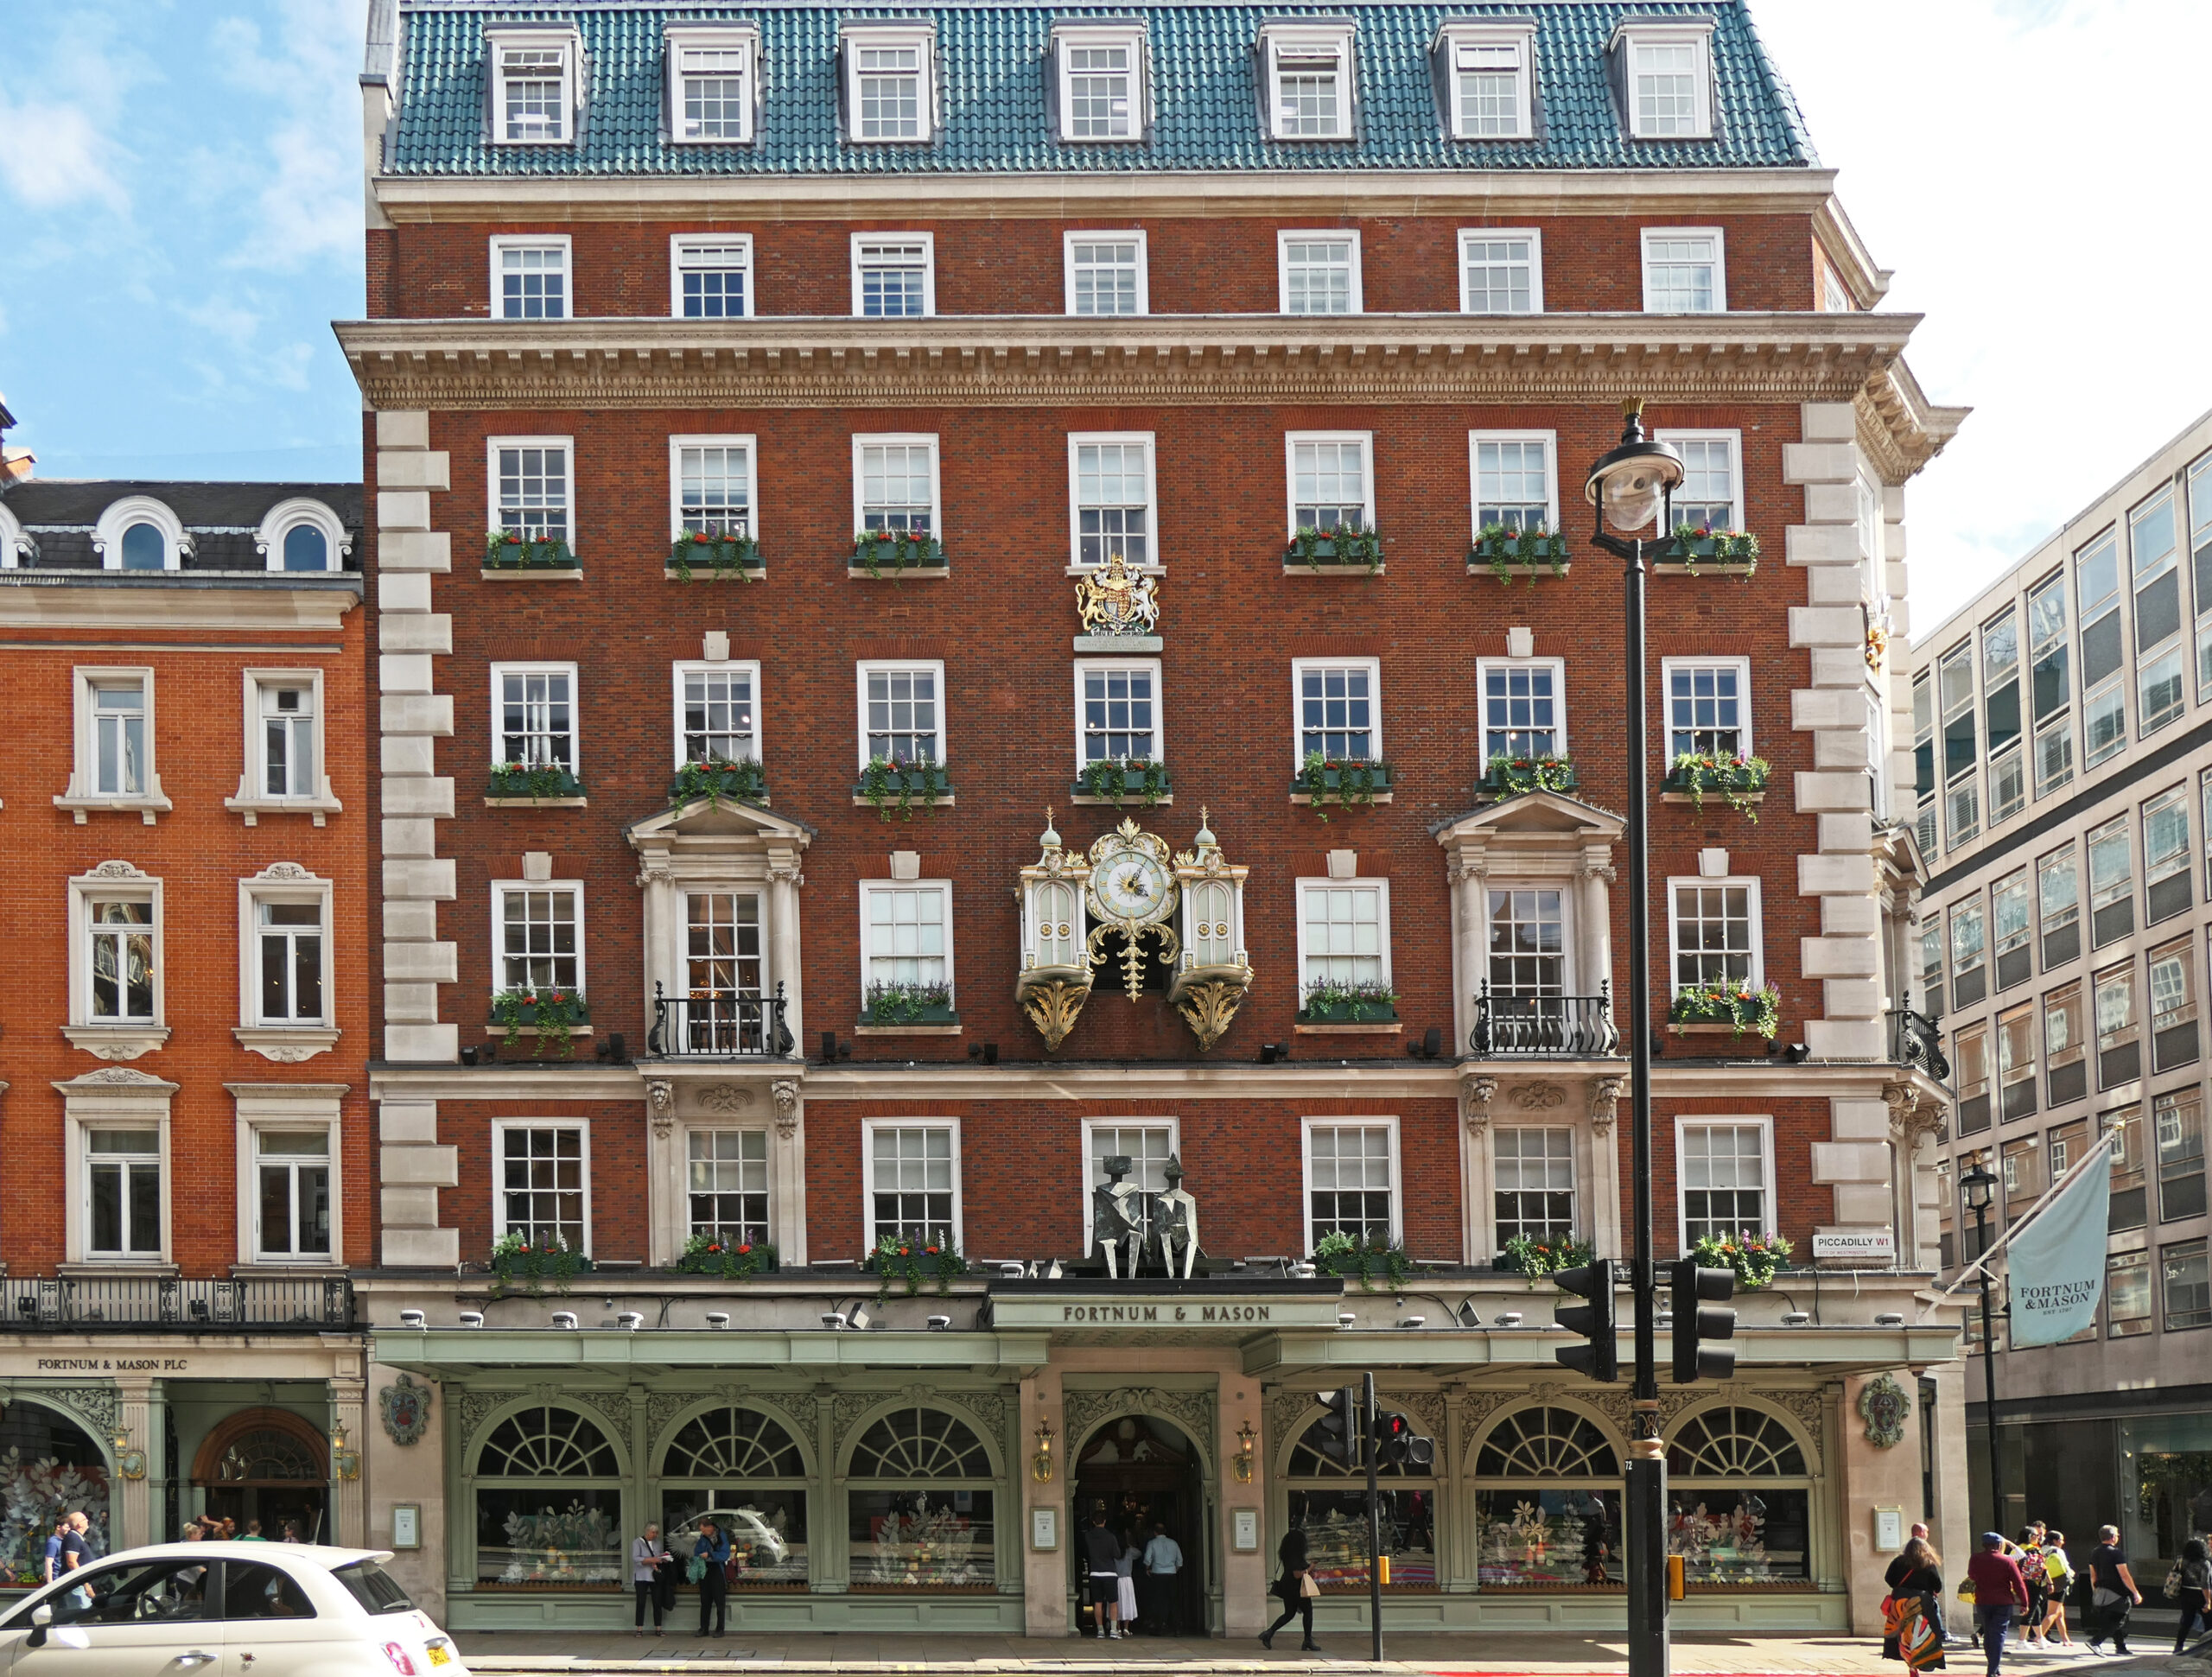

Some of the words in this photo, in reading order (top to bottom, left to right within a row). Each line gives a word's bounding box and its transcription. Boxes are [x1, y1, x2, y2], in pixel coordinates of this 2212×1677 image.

[2020, 1280, 2094, 1298] FORTNUM
[1064, 1306, 1157, 1320] FORTNUM
[1175, 1306, 1185, 1320] &
[1202, 1306, 1269, 1320] MASON
[38, 1359, 99, 1369] FORTNUM
[103, 1360, 111, 1369] &
[116, 1360, 160, 1369] MASON
[164, 1360, 188, 1369] PLC
